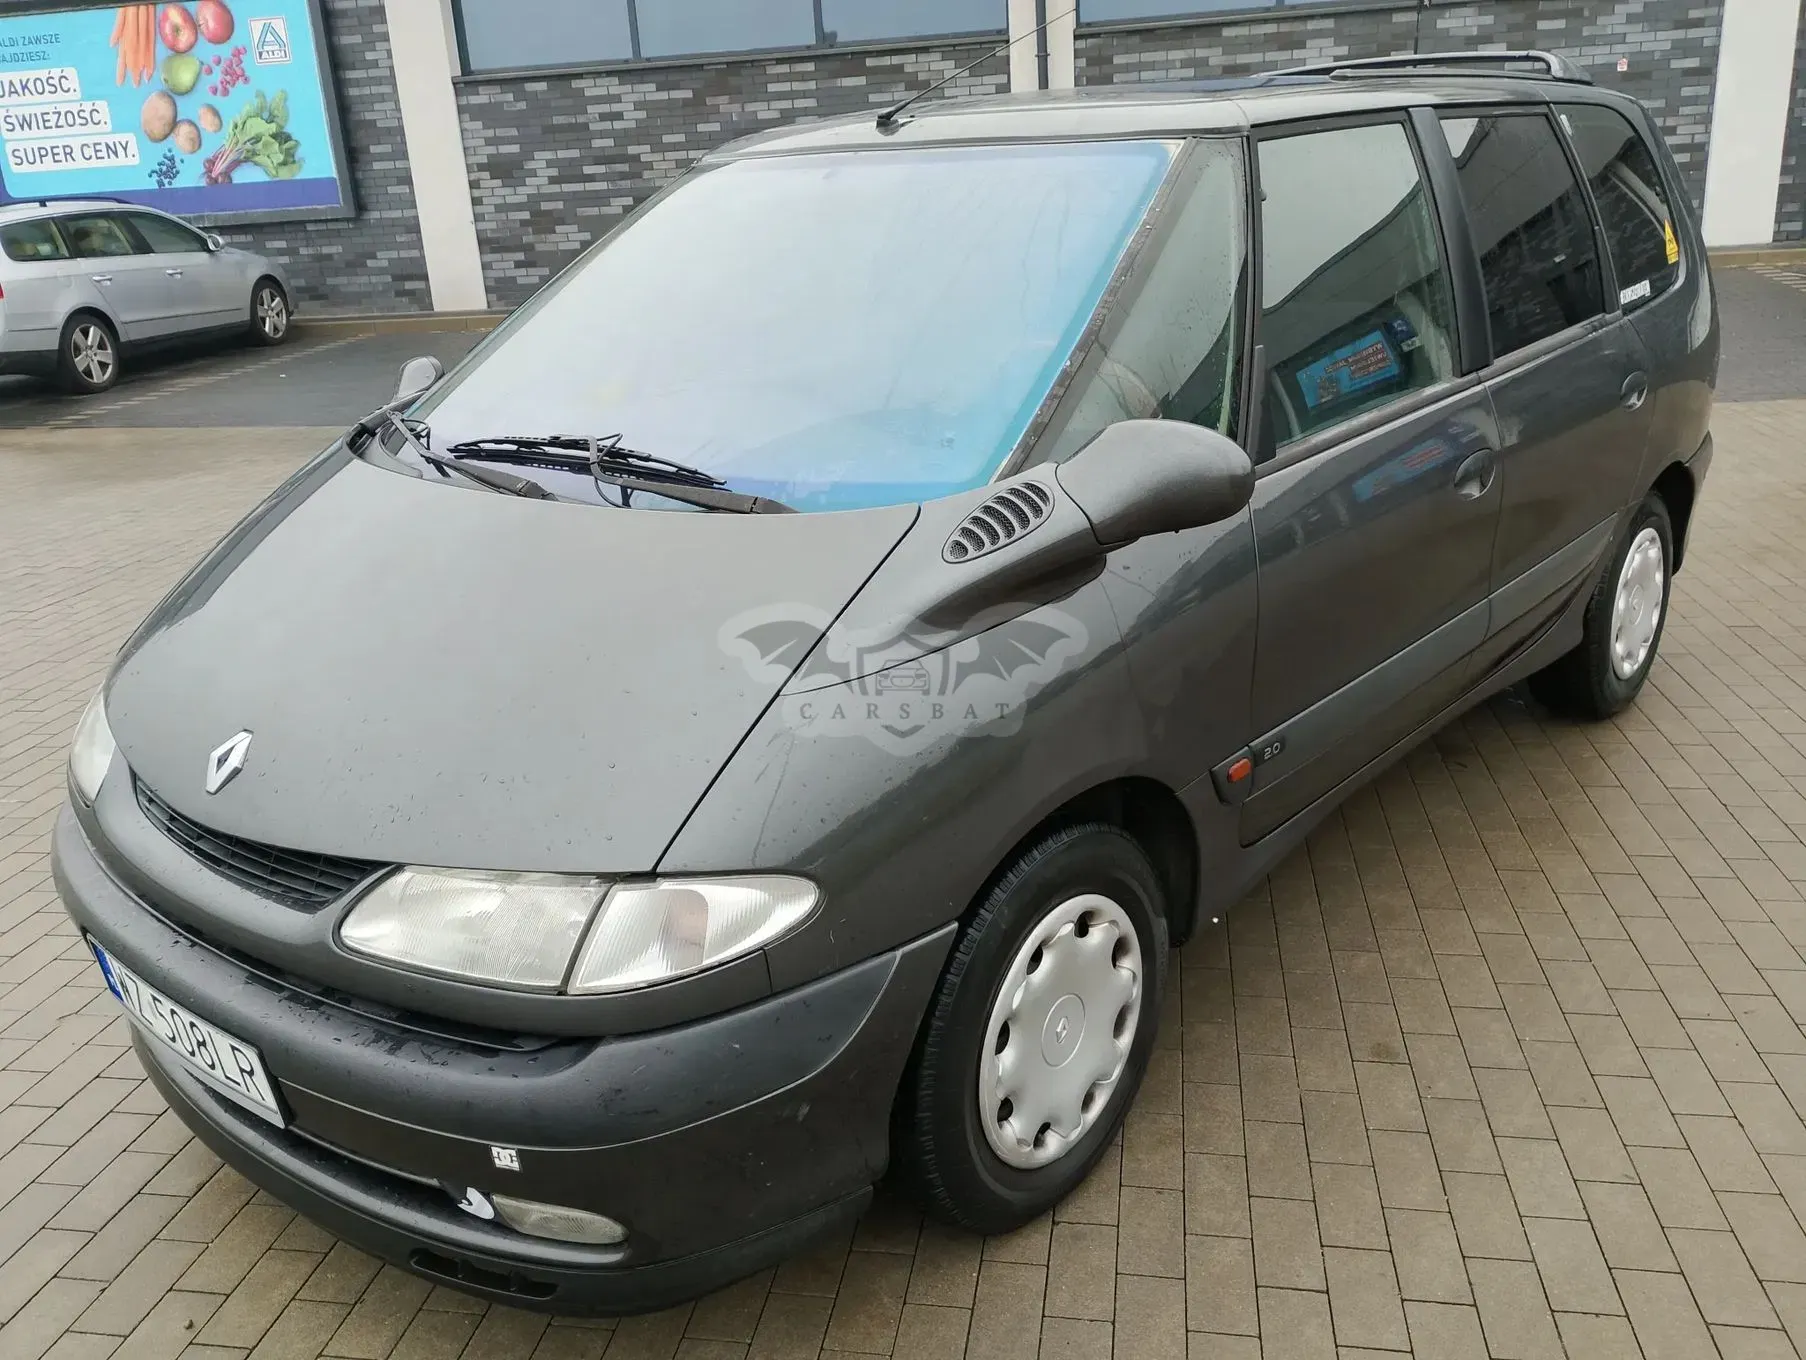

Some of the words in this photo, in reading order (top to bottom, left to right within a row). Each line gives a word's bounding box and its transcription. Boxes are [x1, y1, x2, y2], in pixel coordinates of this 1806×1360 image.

[21, 33, 61, 47] ZAWSZE
[261, 50, 286, 59] ALDI
[0, 69, 77, 99] JAKOŚĆ.
[3, 102, 108, 133] ŚWIEŻOŚĆ.
[11, 144, 76, 167] SUPER
[80, 140, 136, 162] CENY.
[150, 992, 266, 1102] 508LR
